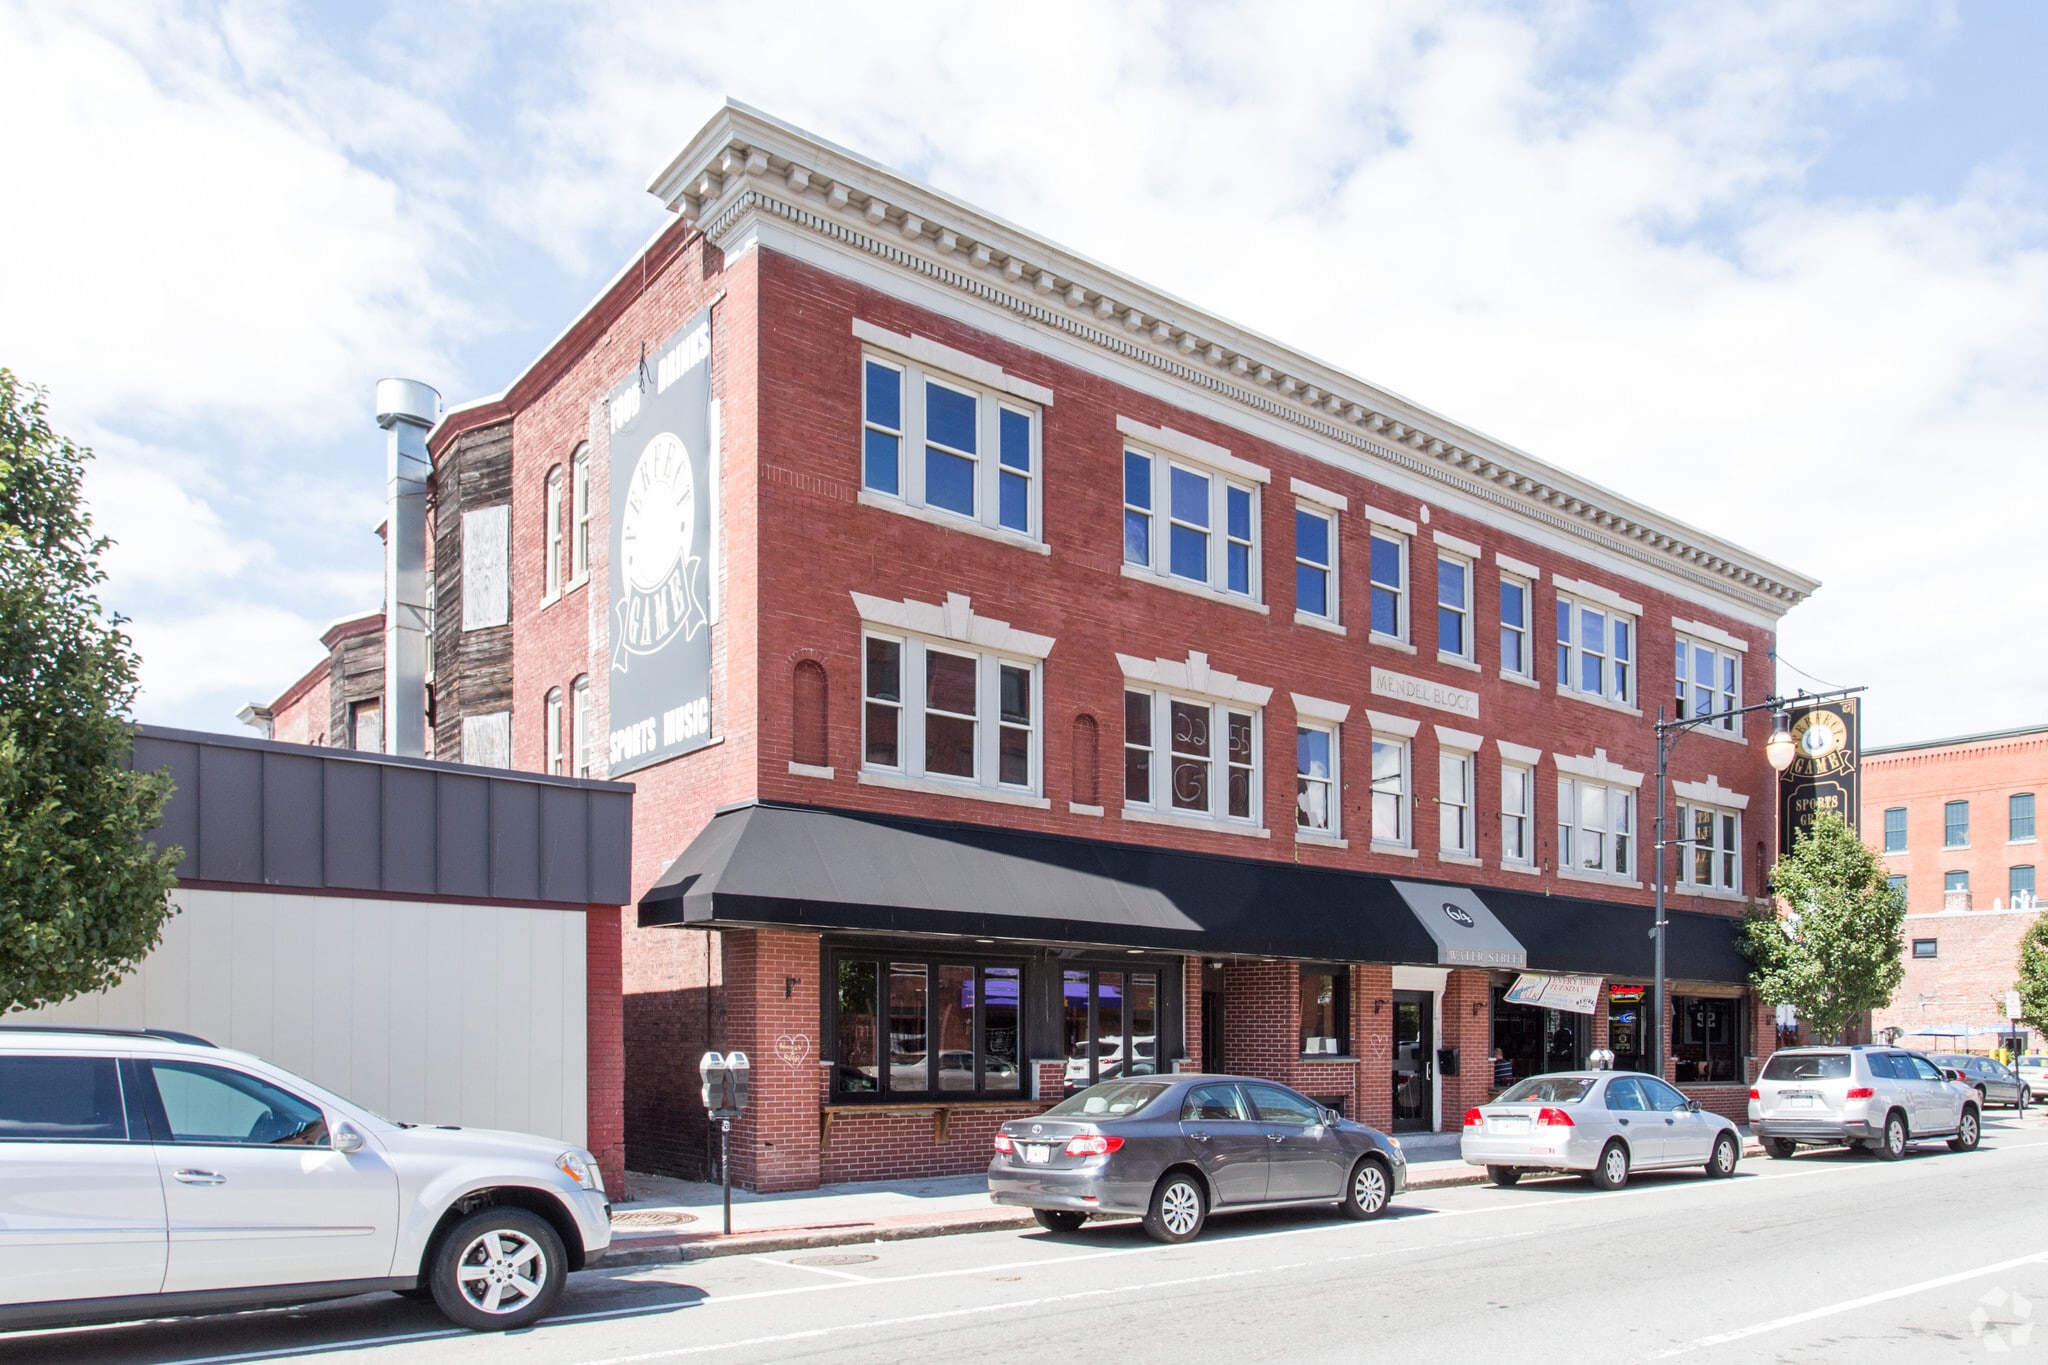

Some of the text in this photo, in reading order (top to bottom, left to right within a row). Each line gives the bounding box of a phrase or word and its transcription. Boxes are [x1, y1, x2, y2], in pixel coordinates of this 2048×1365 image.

[610, 322, 710, 434] FOOD DRINKS
[625, 442, 691, 542] PERFECT
[629, 569, 685, 647] GAME
[1376, 674, 1474, 712] MENDEL BLOCK
[609, 696, 709, 765] SPORTS MUSIC
[1175, 712, 1208, 746] 22
[1794, 752, 1841, 774] GAME
[1795, 795, 1839, 811] SPORTS
[1446, 906, 1473, 923] 64
[1449, 950, 1524, 964] WATER STREET
[1549, 984, 1584, 994] TUESDAY
[1552, 976, 1601, 987] EVERY THIRD
